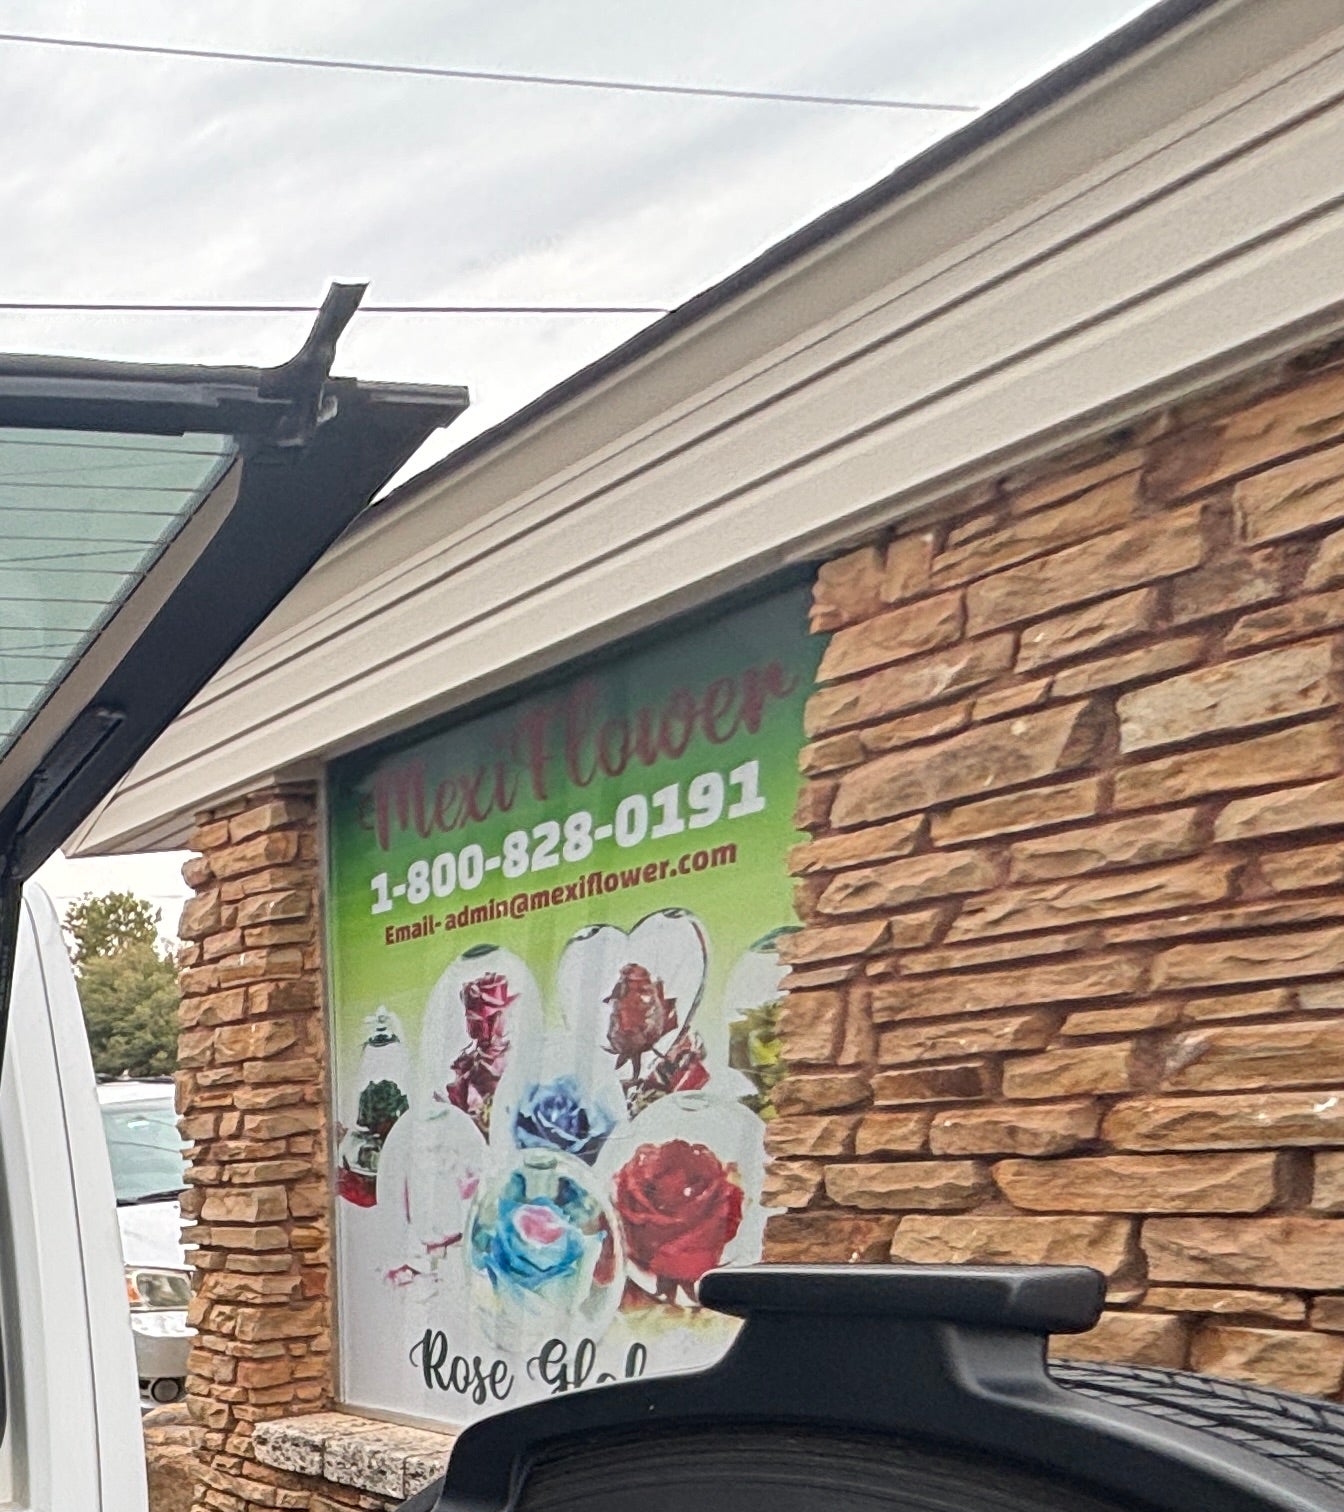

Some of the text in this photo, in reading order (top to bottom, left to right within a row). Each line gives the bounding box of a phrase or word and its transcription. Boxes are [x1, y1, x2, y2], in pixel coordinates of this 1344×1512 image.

[370, 760, 767, 915] 1-800-828-0191
[444, 842, 738, 932] admin@mexiflower.com
[409, 1328, 515, 1405] Rose
